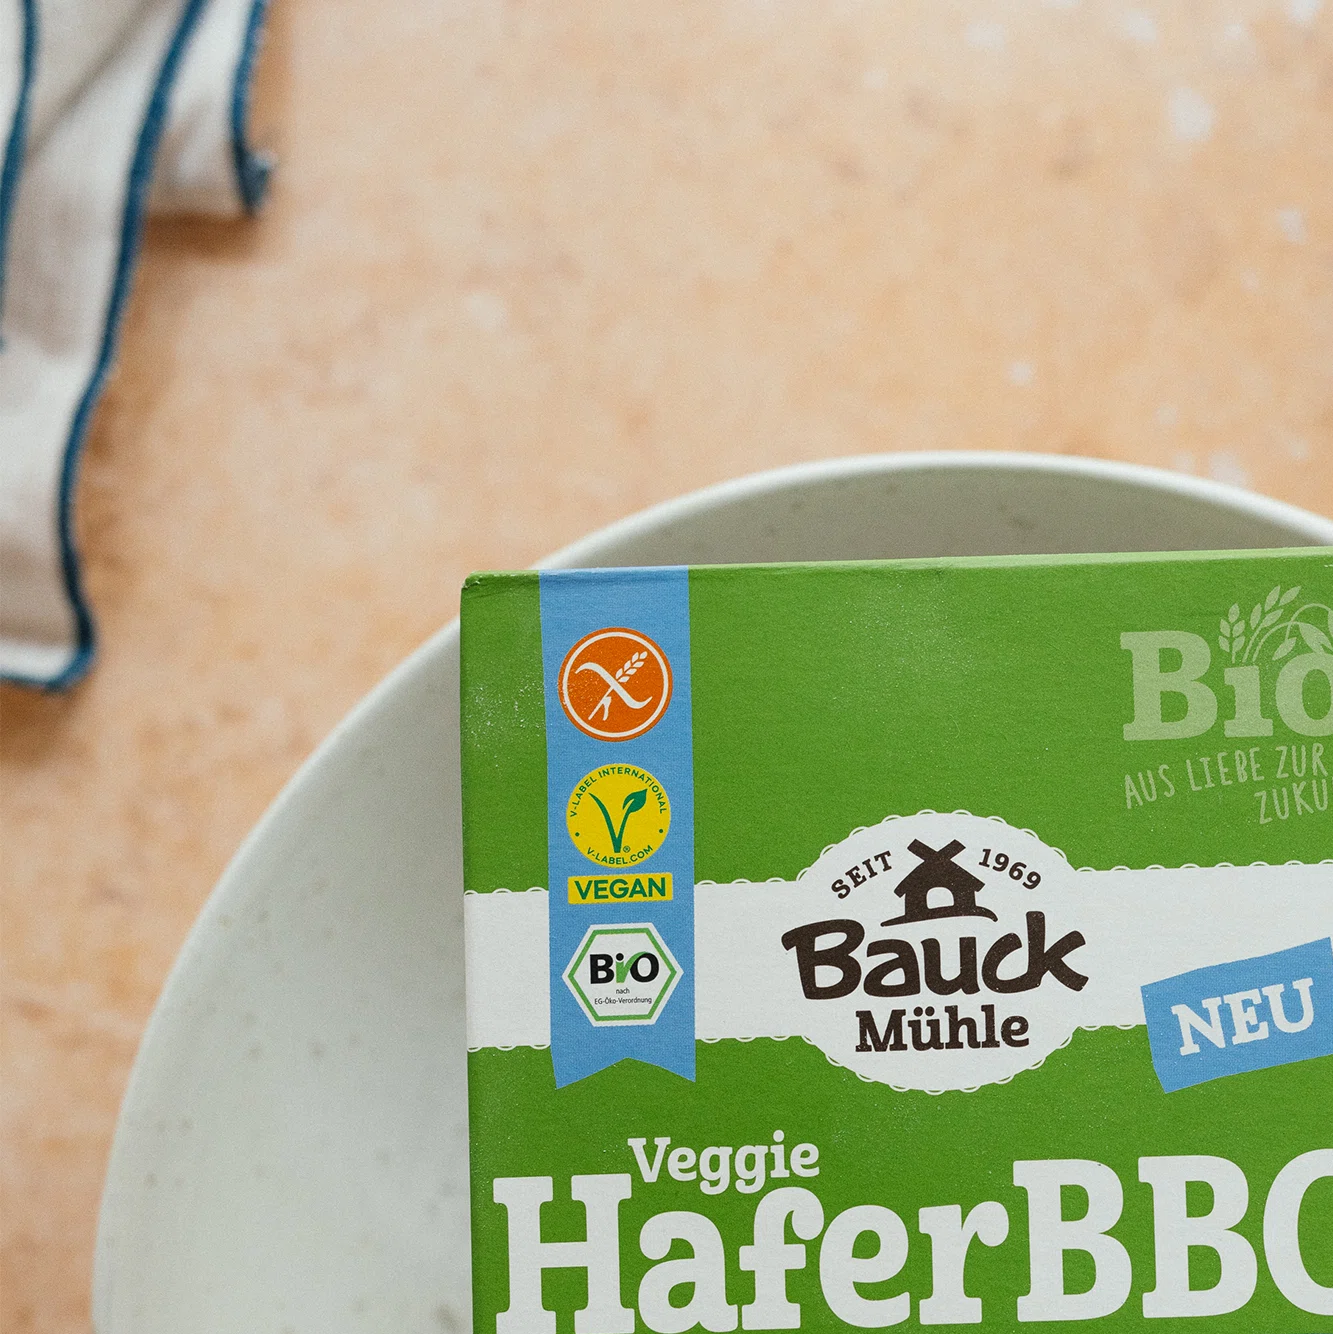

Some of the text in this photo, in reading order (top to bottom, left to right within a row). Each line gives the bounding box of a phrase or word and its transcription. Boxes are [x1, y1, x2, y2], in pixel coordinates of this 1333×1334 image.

[569, 766, 667, 818] V-LABEL INTERNATIONAL
[1124, 742, 1329, 809] AUS LIEBE ZUR
[587, 844, 654, 865] V-LABEL.COM
[831, 848, 1042, 900] SEIT 1969
[574, 877, 666, 900] VEGAN
[781, 911, 1090, 1000] Bauck
[594, 996, 653, 1005] EG-Öko-Verordnung
[615, 987, 631, 995] nach
[1171, 977, 1315, 1057] NEU
[855, 1004, 1030, 1052] Mühle
[627, 1130, 820, 1195] Veggie
